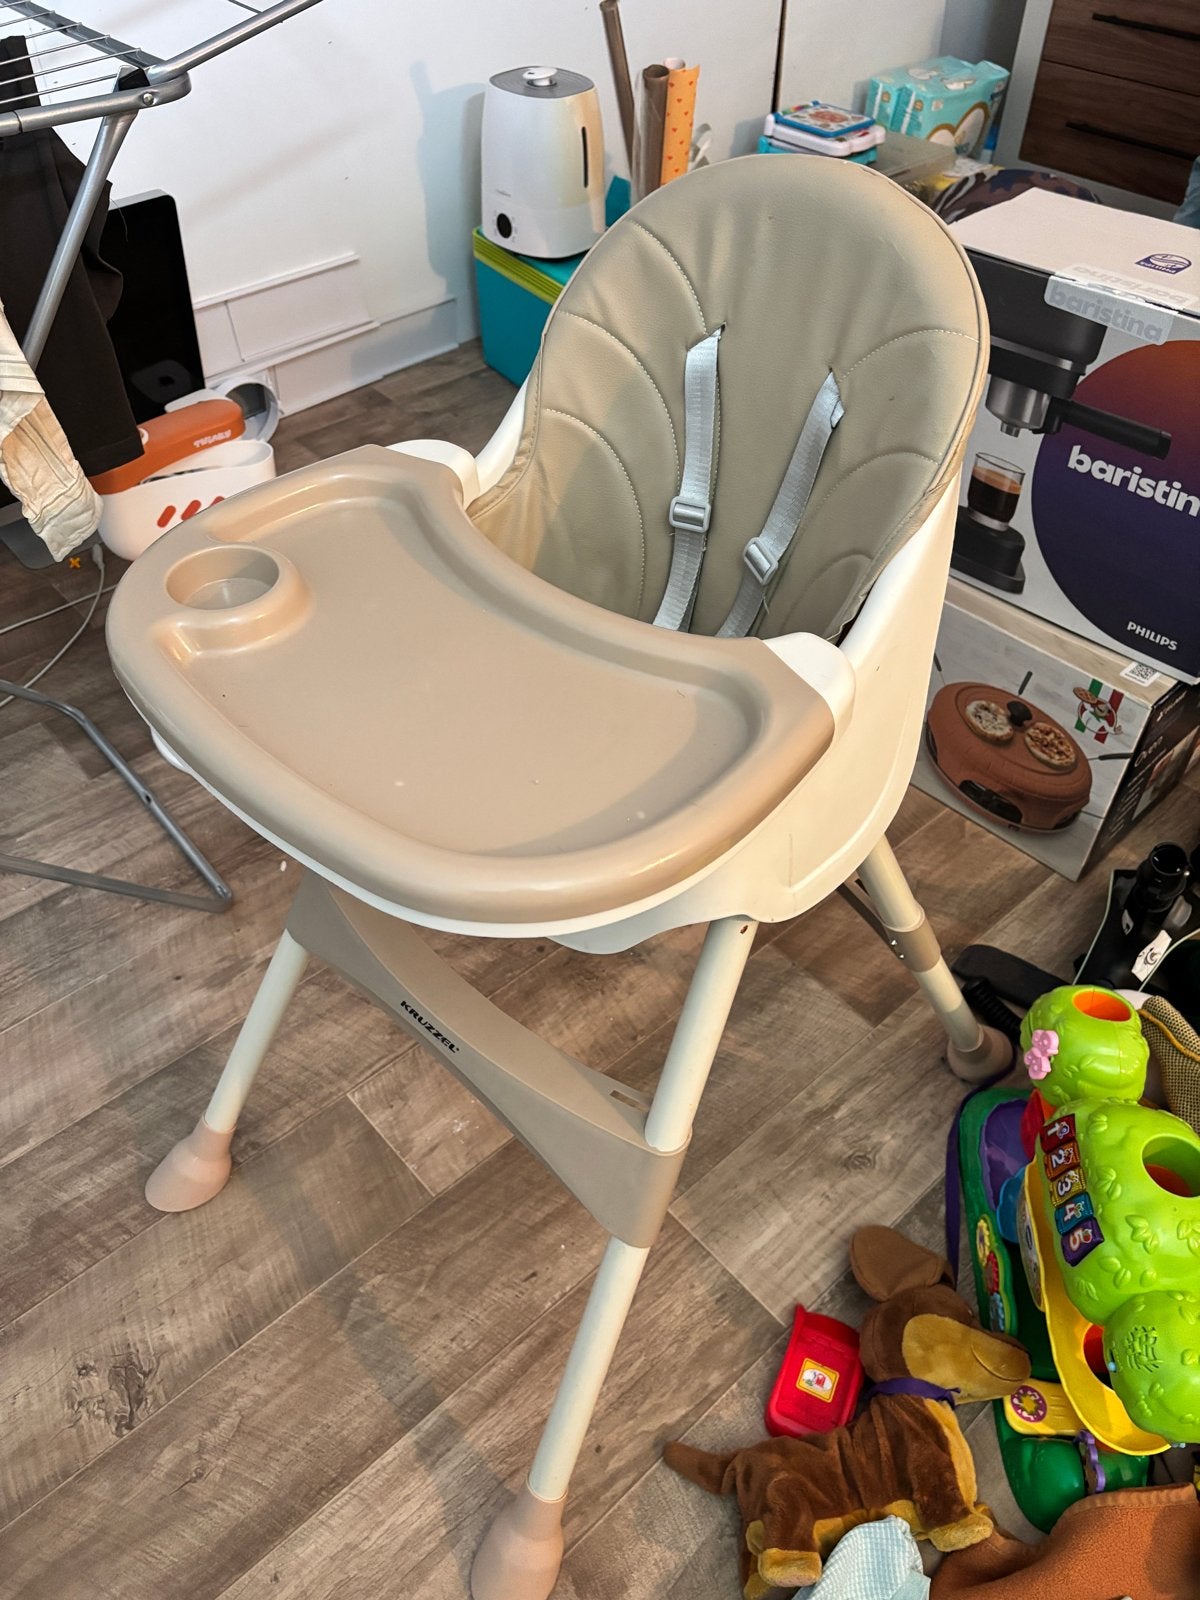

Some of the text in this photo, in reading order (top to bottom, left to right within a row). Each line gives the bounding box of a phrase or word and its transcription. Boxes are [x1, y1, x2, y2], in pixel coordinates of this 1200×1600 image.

[1049, 283, 1164, 341] baristina
[1067, 445, 1200, 517] baristin
[1127, 621, 1178, 650] PHILIPS
[400, 1000, 456, 1053] KRUZZEL
[1051, 1149, 1065, 1169] 2
[1057, 1178, 1072, 1197] 3
[1064, 1203, 1077, 1222] 4
[1069, 1228, 1084, 1251] 5
